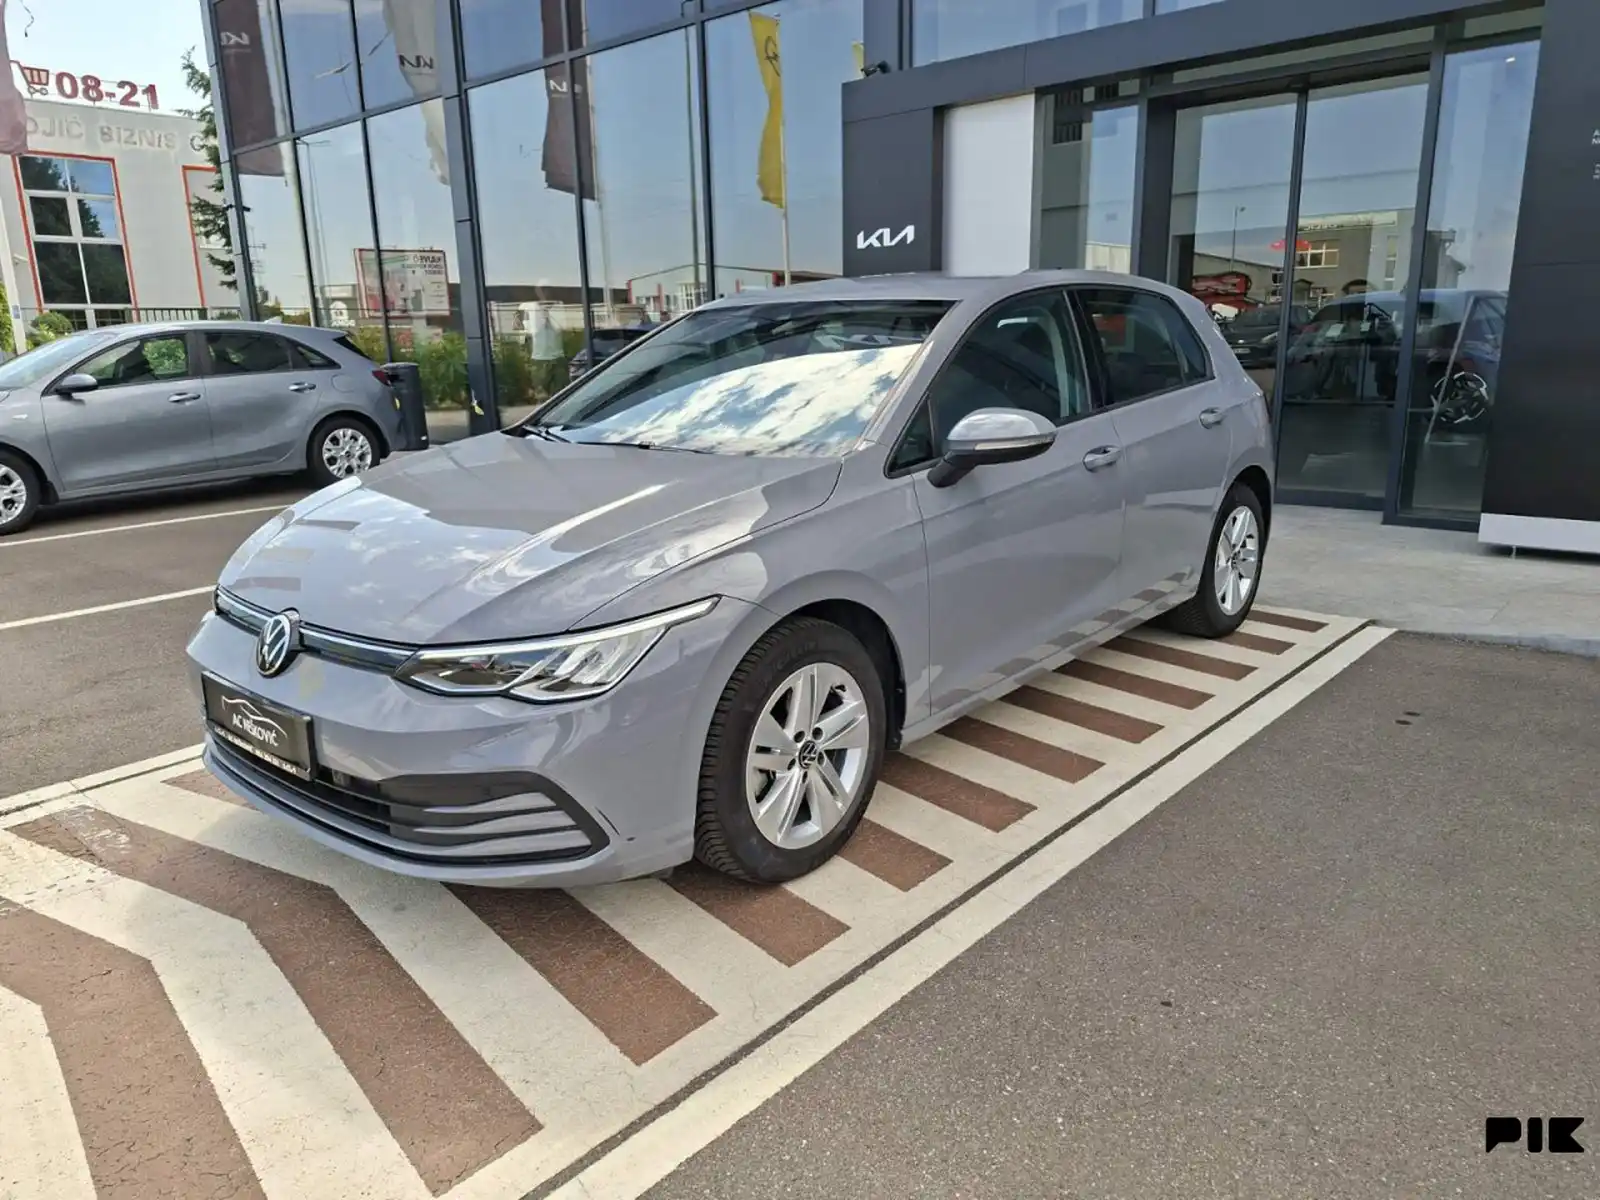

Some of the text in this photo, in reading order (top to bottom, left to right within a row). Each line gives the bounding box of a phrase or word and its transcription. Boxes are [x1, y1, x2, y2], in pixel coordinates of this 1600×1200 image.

[56, 72, 159, 109] 08-21
[99, 125, 177, 149] BIZNIS
[857, 224, 915, 249] KIA
